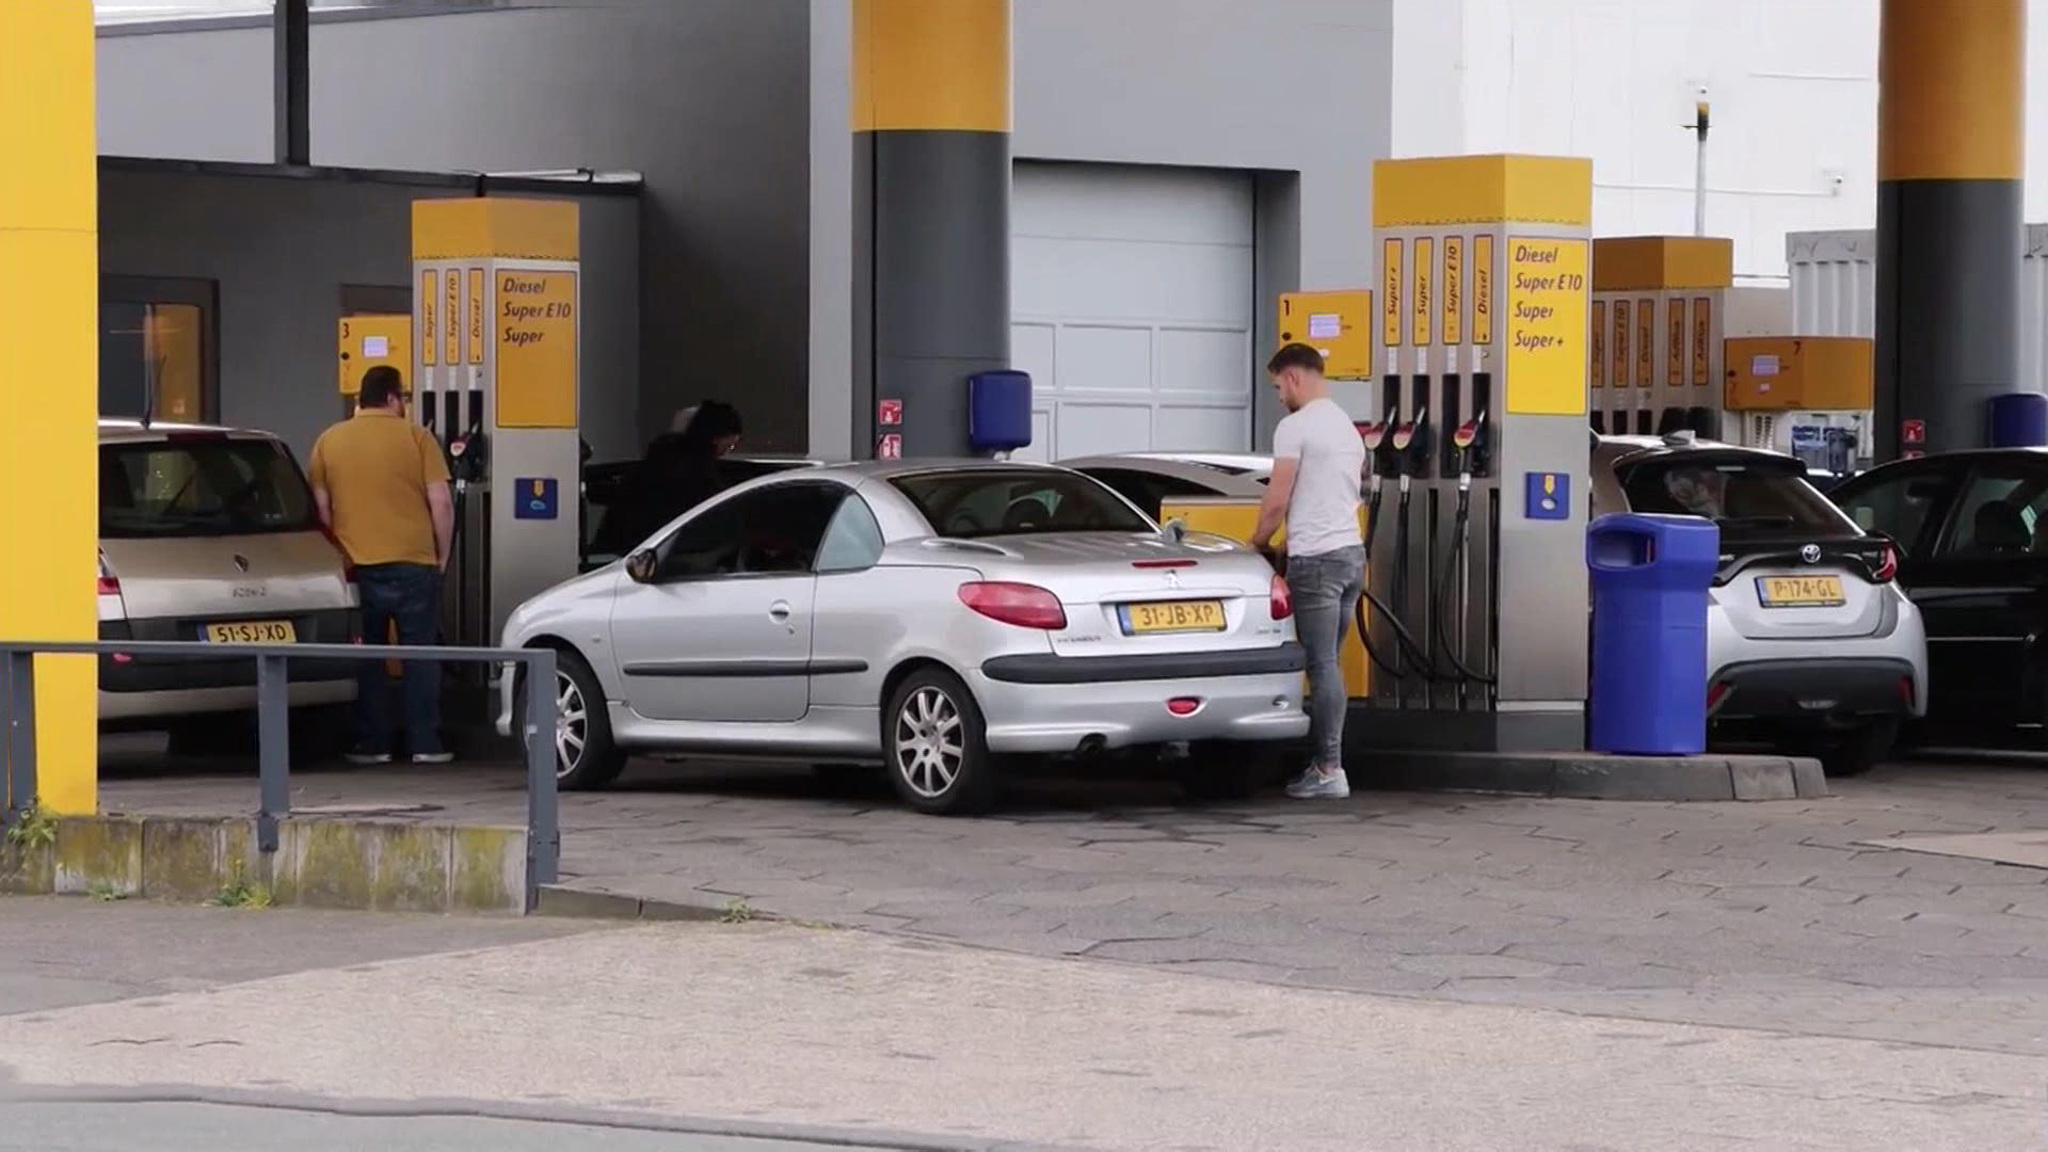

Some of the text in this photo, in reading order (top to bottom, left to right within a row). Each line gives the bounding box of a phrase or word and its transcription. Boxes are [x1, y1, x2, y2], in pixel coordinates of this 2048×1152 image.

[1515, 244, 1559, 263] Diesel
[503, 277, 547, 294] Diesel
[1446, 245, 1460, 316] Super E10
[1477, 268, 1488, 315] Diesel
[1514, 272, 1583, 294] Super E10
[1388, 276, 1399, 316] Super
[1417, 275, 1429, 316] Super
[471, 298, 481, 338] Diesel
[503, 301, 572, 322] Super E10
[1283, 299, 1290, 316] 1
[1514, 300, 1554, 323] Super
[343, 322, 350, 339] 3
[426, 302, 435, 338] Super
[448, 302, 458, 338] Super
[503, 327, 545, 347] Super
[1514, 329, 1554, 352] Super
[1793, 340, 1802, 356] 7
[1774, 580, 1838, 598] P-174-GL
[1140, 604, 1214, 626] 31-JB-XP
[217, 624, 287, 643] 51-SJ-XD
